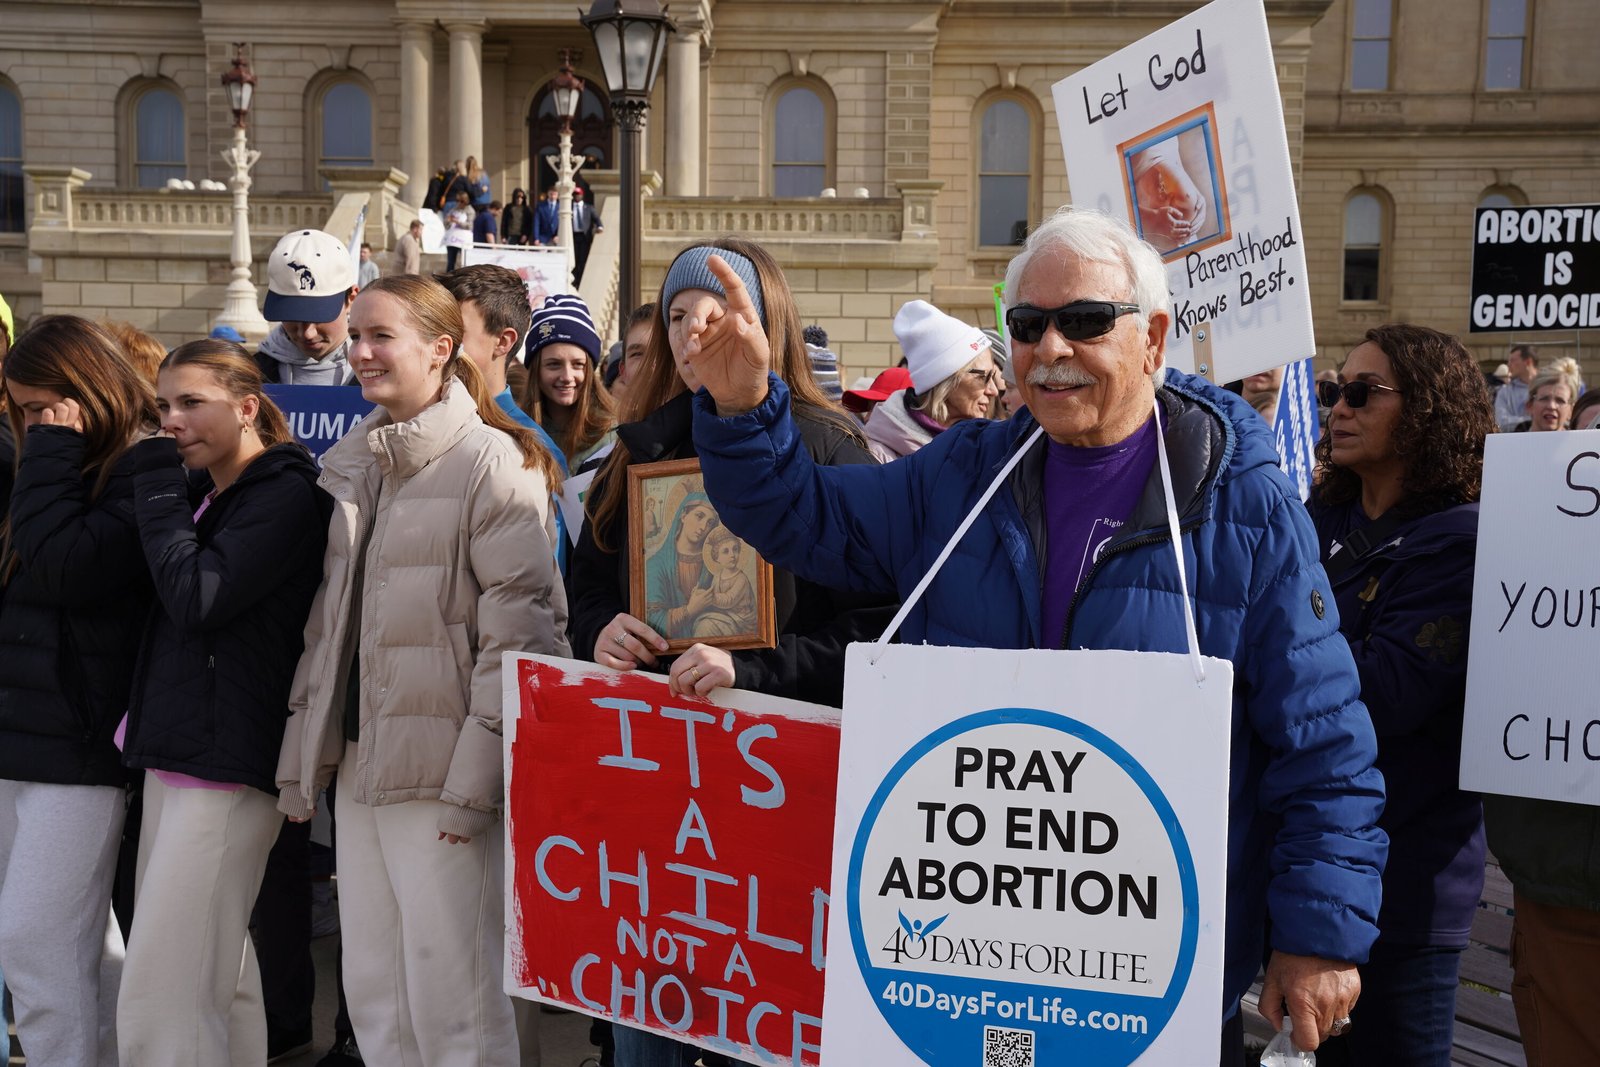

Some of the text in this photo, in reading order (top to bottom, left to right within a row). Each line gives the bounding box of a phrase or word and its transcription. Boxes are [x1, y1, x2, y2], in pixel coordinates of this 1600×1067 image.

[1082, 29, 1207, 125] Let God
[1185, 216, 1297, 289] Parenthood
[1543, 250, 1574, 286] IS
[1173, 257, 1295, 339] Knows Best.
[590, 696, 786, 810] IT'S
[953, 746, 1087, 794] PRAY
[674, 797, 717, 861] A
[917, 801, 1119, 855] TO END
[878, 856, 1158, 920] ABORTION
[616, 916, 758, 988] NOT A
[881, 926, 928, 965] 40
[929, 934, 1004, 969] DAYS
[1007, 941, 1077, 978] FOR
[882, 980, 1149, 1035] 40DaysForLife.com
